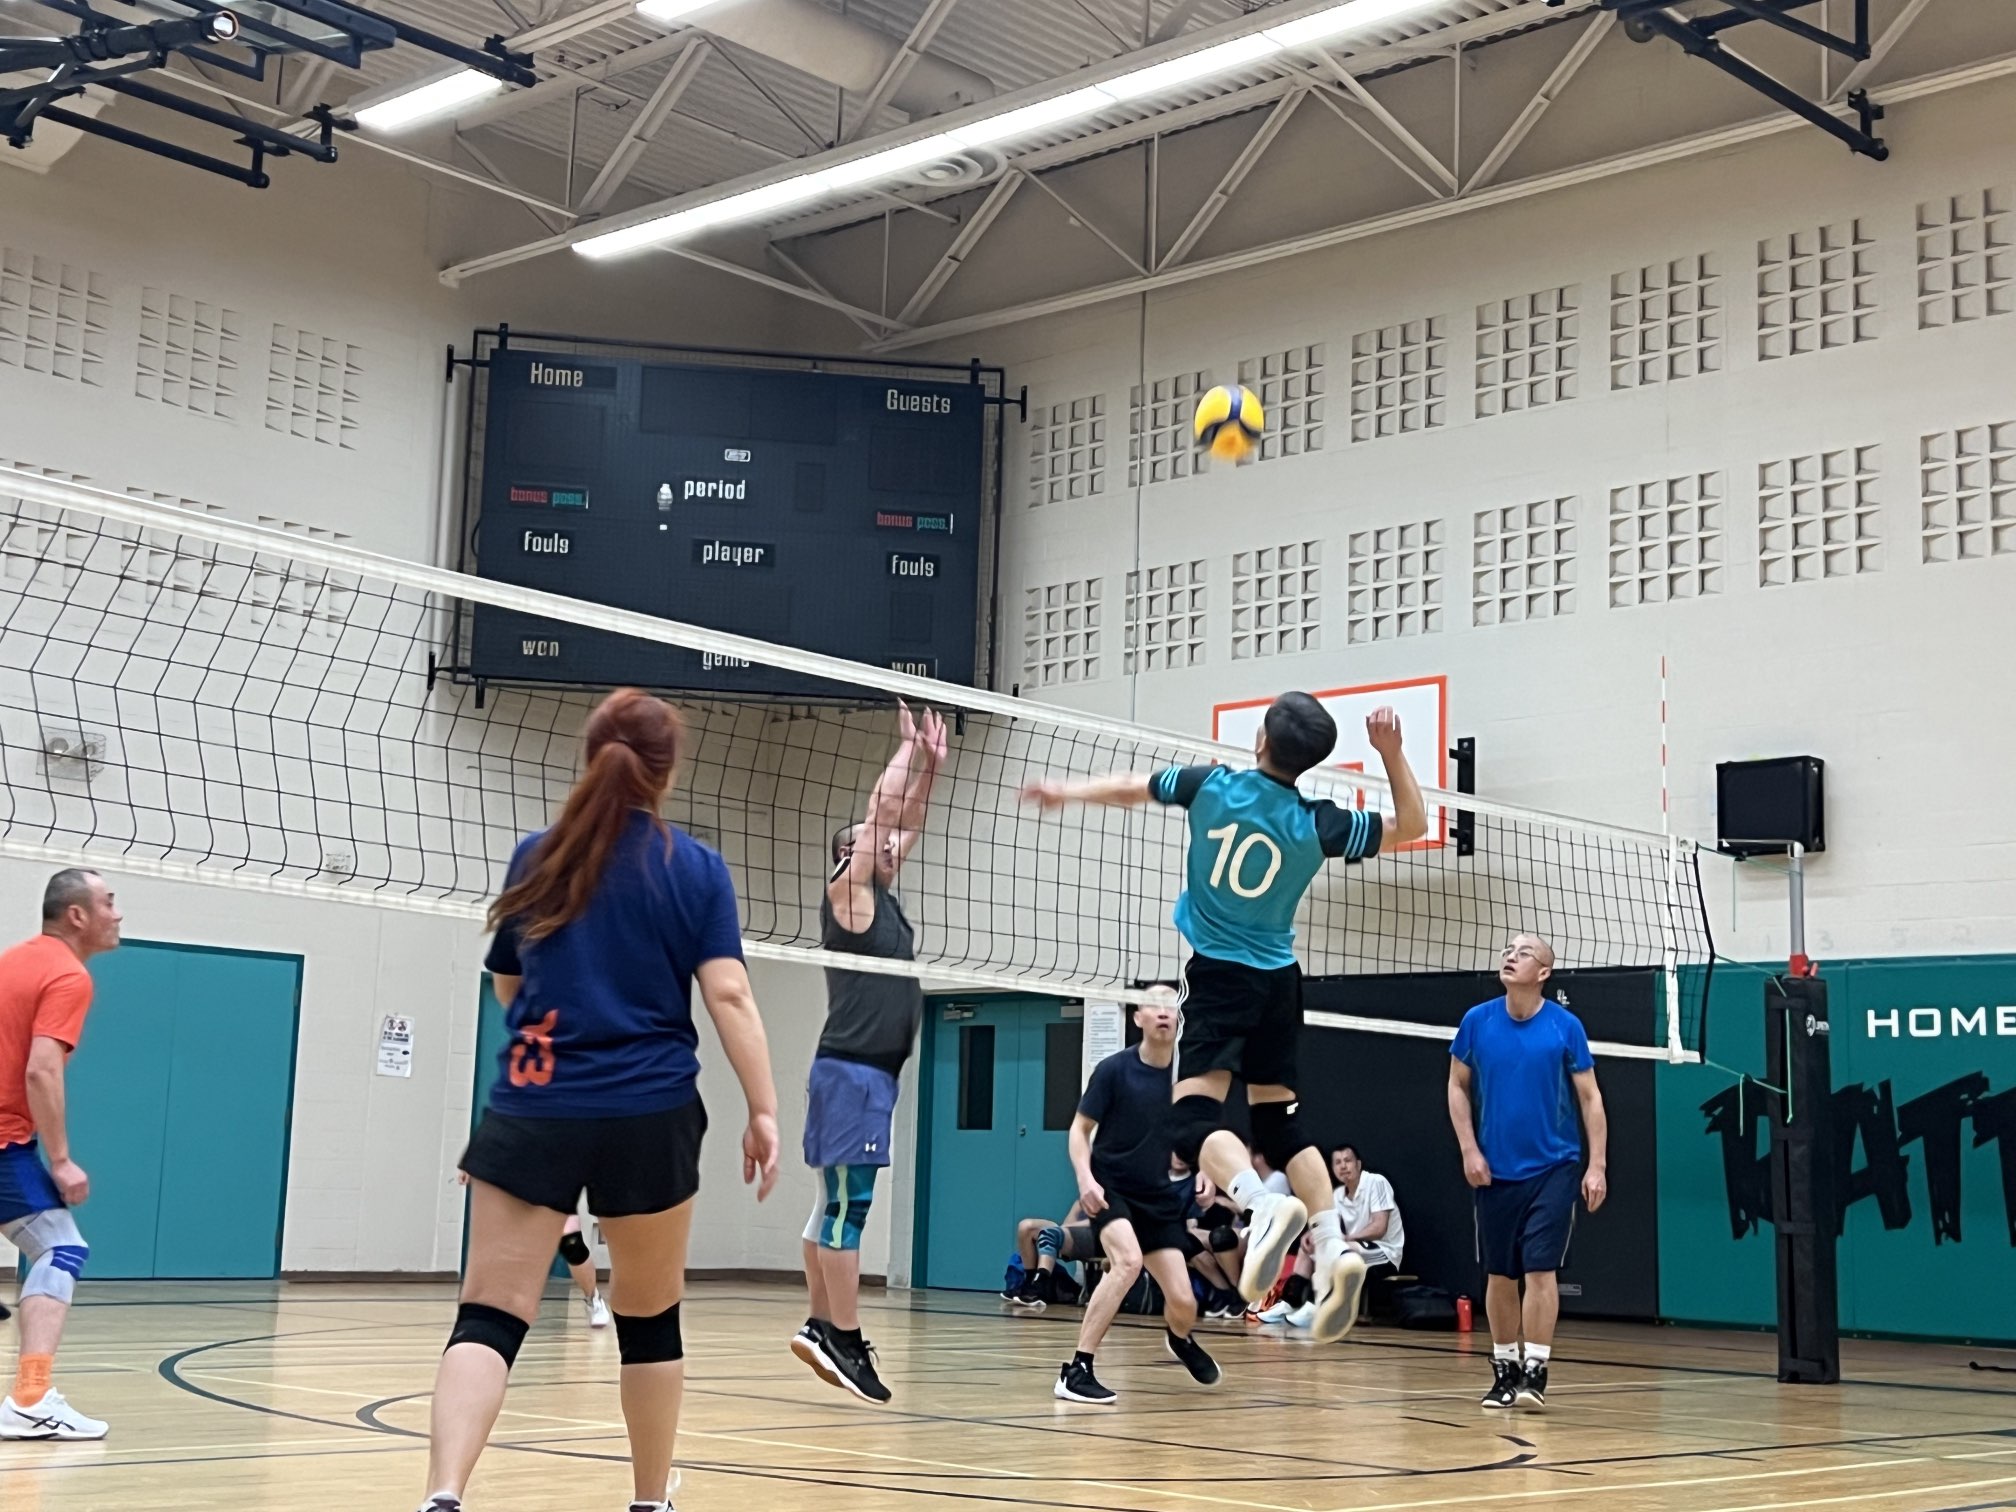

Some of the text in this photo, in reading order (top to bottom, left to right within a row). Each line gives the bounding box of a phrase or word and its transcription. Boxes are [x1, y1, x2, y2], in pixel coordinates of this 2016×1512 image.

[530, 362, 584, 388] Home
[886, 388, 951, 414] Guests
[510, 486, 548, 503] bonus
[684, 479, 746, 500] period
[876, 511, 913, 528] bonus
[524, 530, 569, 554] fouls
[703, 540, 764, 567] player
[892, 554, 935, 577] fouls
[522, 640, 560, 657] won
[1206, 822, 1282, 898] 10
[1867, 1006, 2016, 1038] HOME
